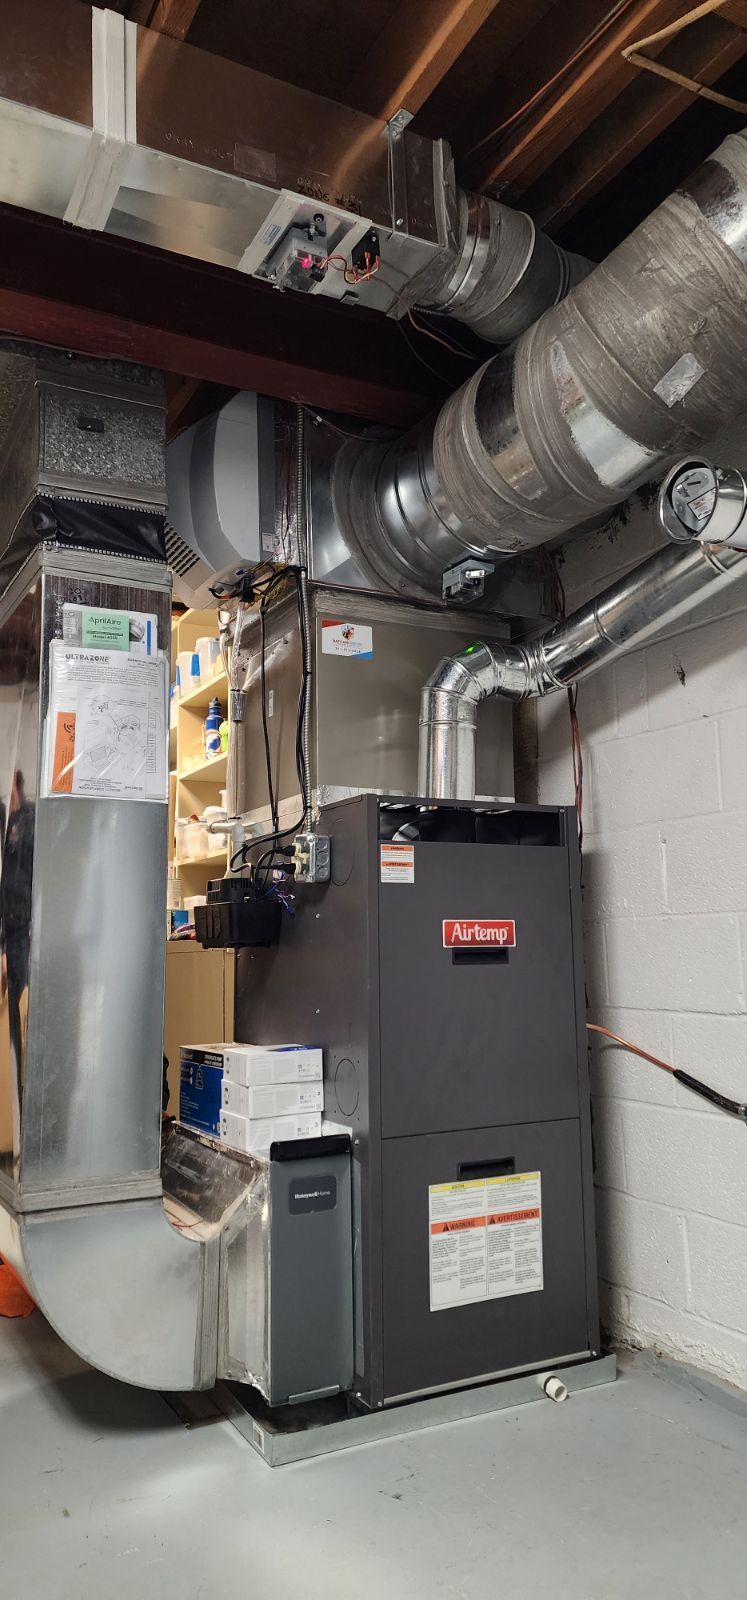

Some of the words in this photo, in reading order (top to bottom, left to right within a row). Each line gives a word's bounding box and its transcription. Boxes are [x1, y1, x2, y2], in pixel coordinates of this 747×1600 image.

[89, 616, 122, 626] AprilAire
[65, 653, 110, 663] ULTRAZONE
[451, 922, 508, 945] Airtemp
[294, 1191, 318, 1200] Honeywell
[497, 1210, 538, 1223] AVERTISSEMENT
[450, 1220, 476, 1231] WARNING
